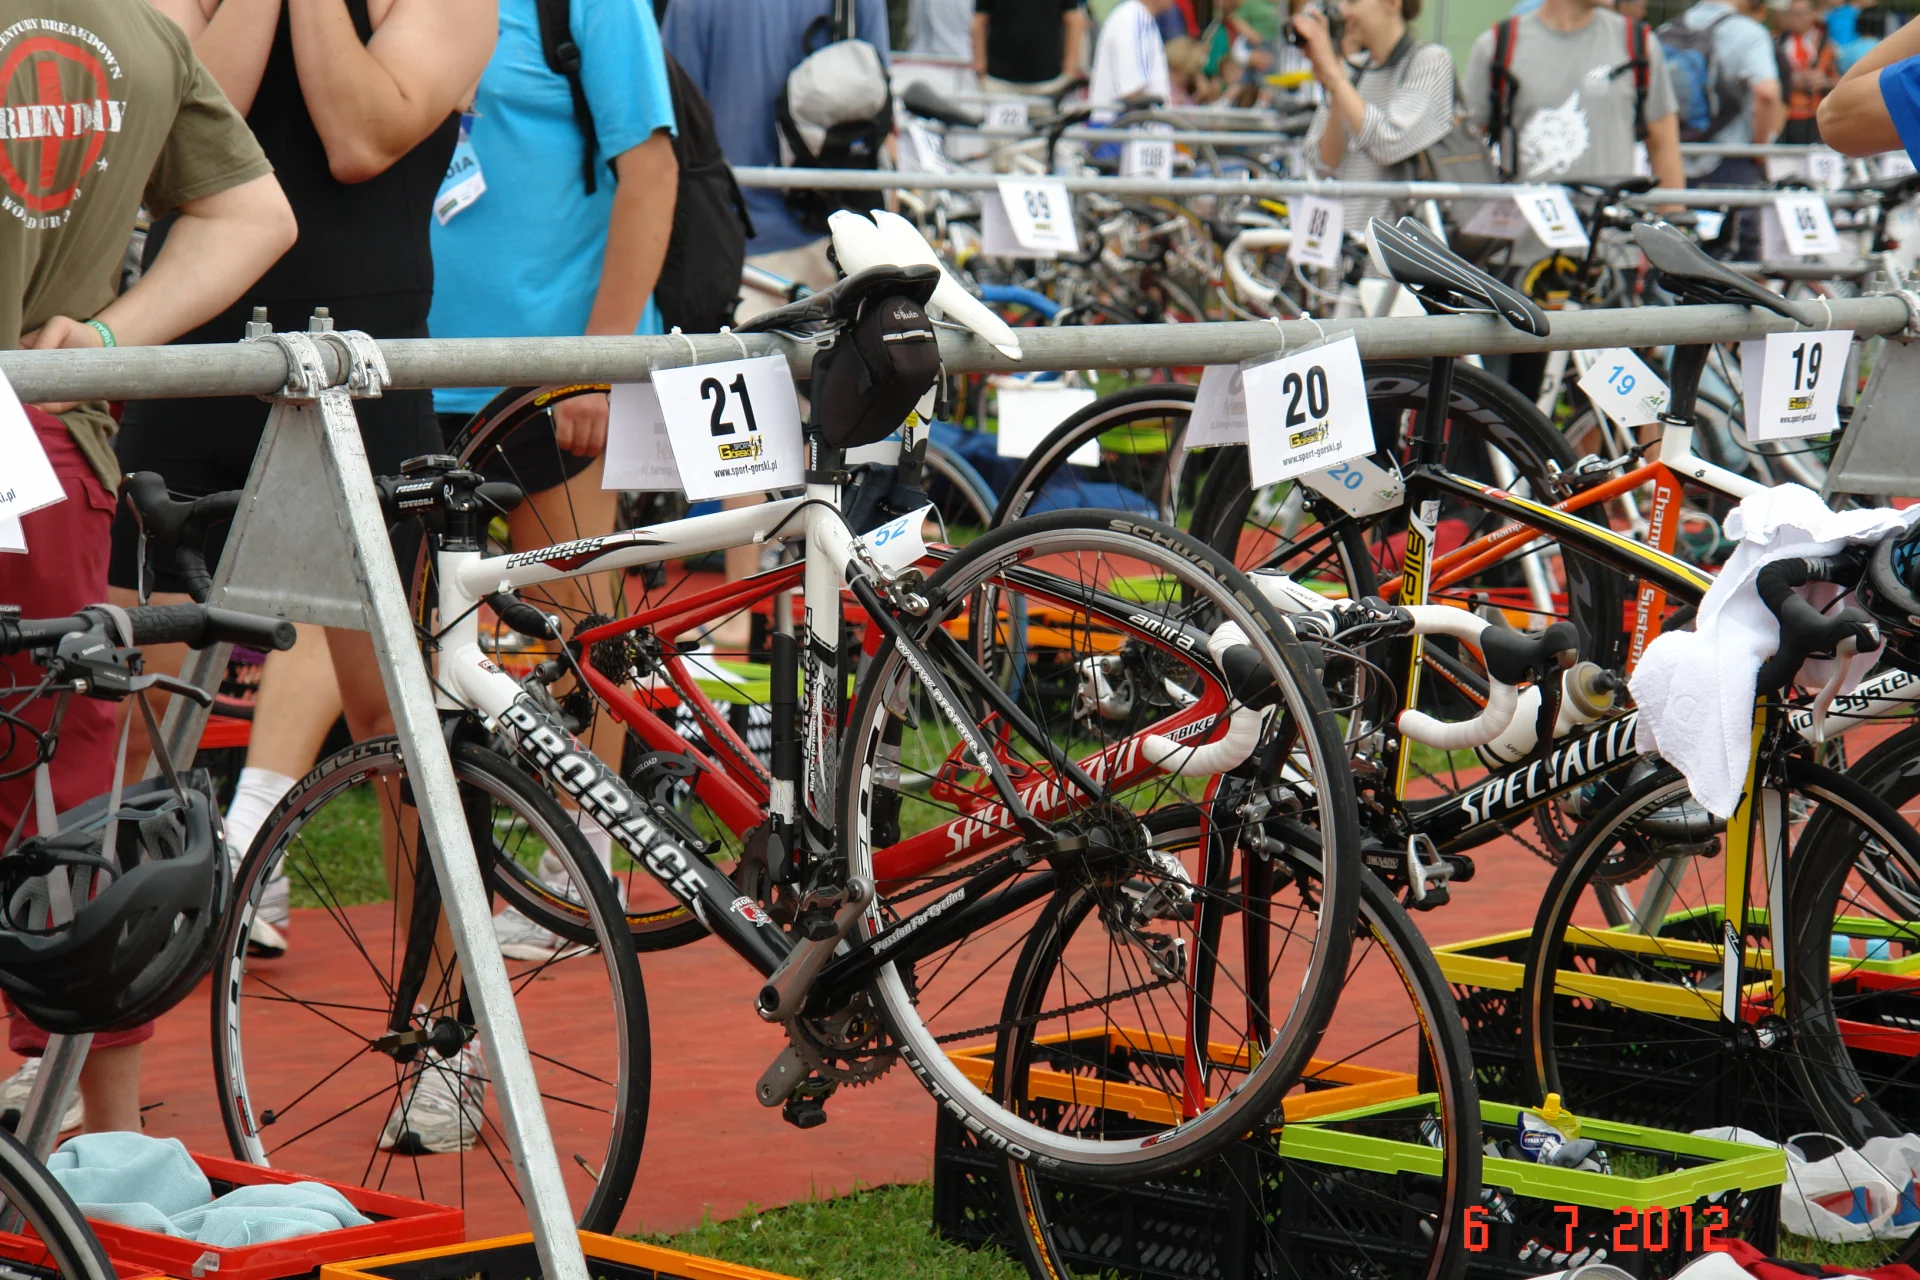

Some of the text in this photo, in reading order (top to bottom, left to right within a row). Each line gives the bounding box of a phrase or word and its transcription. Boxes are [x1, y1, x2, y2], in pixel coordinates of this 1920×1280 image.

[0, 18, 123, 80] ENTURY BREAKDOWN
[1024, 189, 1051, 219] 89
[1607, 365, 1636, 396] 19
[1792, 341, 1823, 391] 19
[700, 373, 758, 437] 21
[1282, 364, 1330, 429] 20
[713, 459, 778, 478] www.sport-gorski.pl
[1283, 440, 1343, 467] www.sport-gorski.pl
[1326, 462, 1365, 490] 20
[874, 518, 909, 547] 52
[1648, 486, 1671, 550] Champ
[506, 535, 608, 570] PRORACE
[1108, 518, 1272, 633] SCHWALBE
[1128, 613, 1196, 651] amira
[895, 635, 993, 776] www.prorace.be
[1461, 711, 1639, 831] SPECIALIZ
[499, 700, 710, 903] PRORACE
[899, 1044, 1031, 1160] ULTREMO
